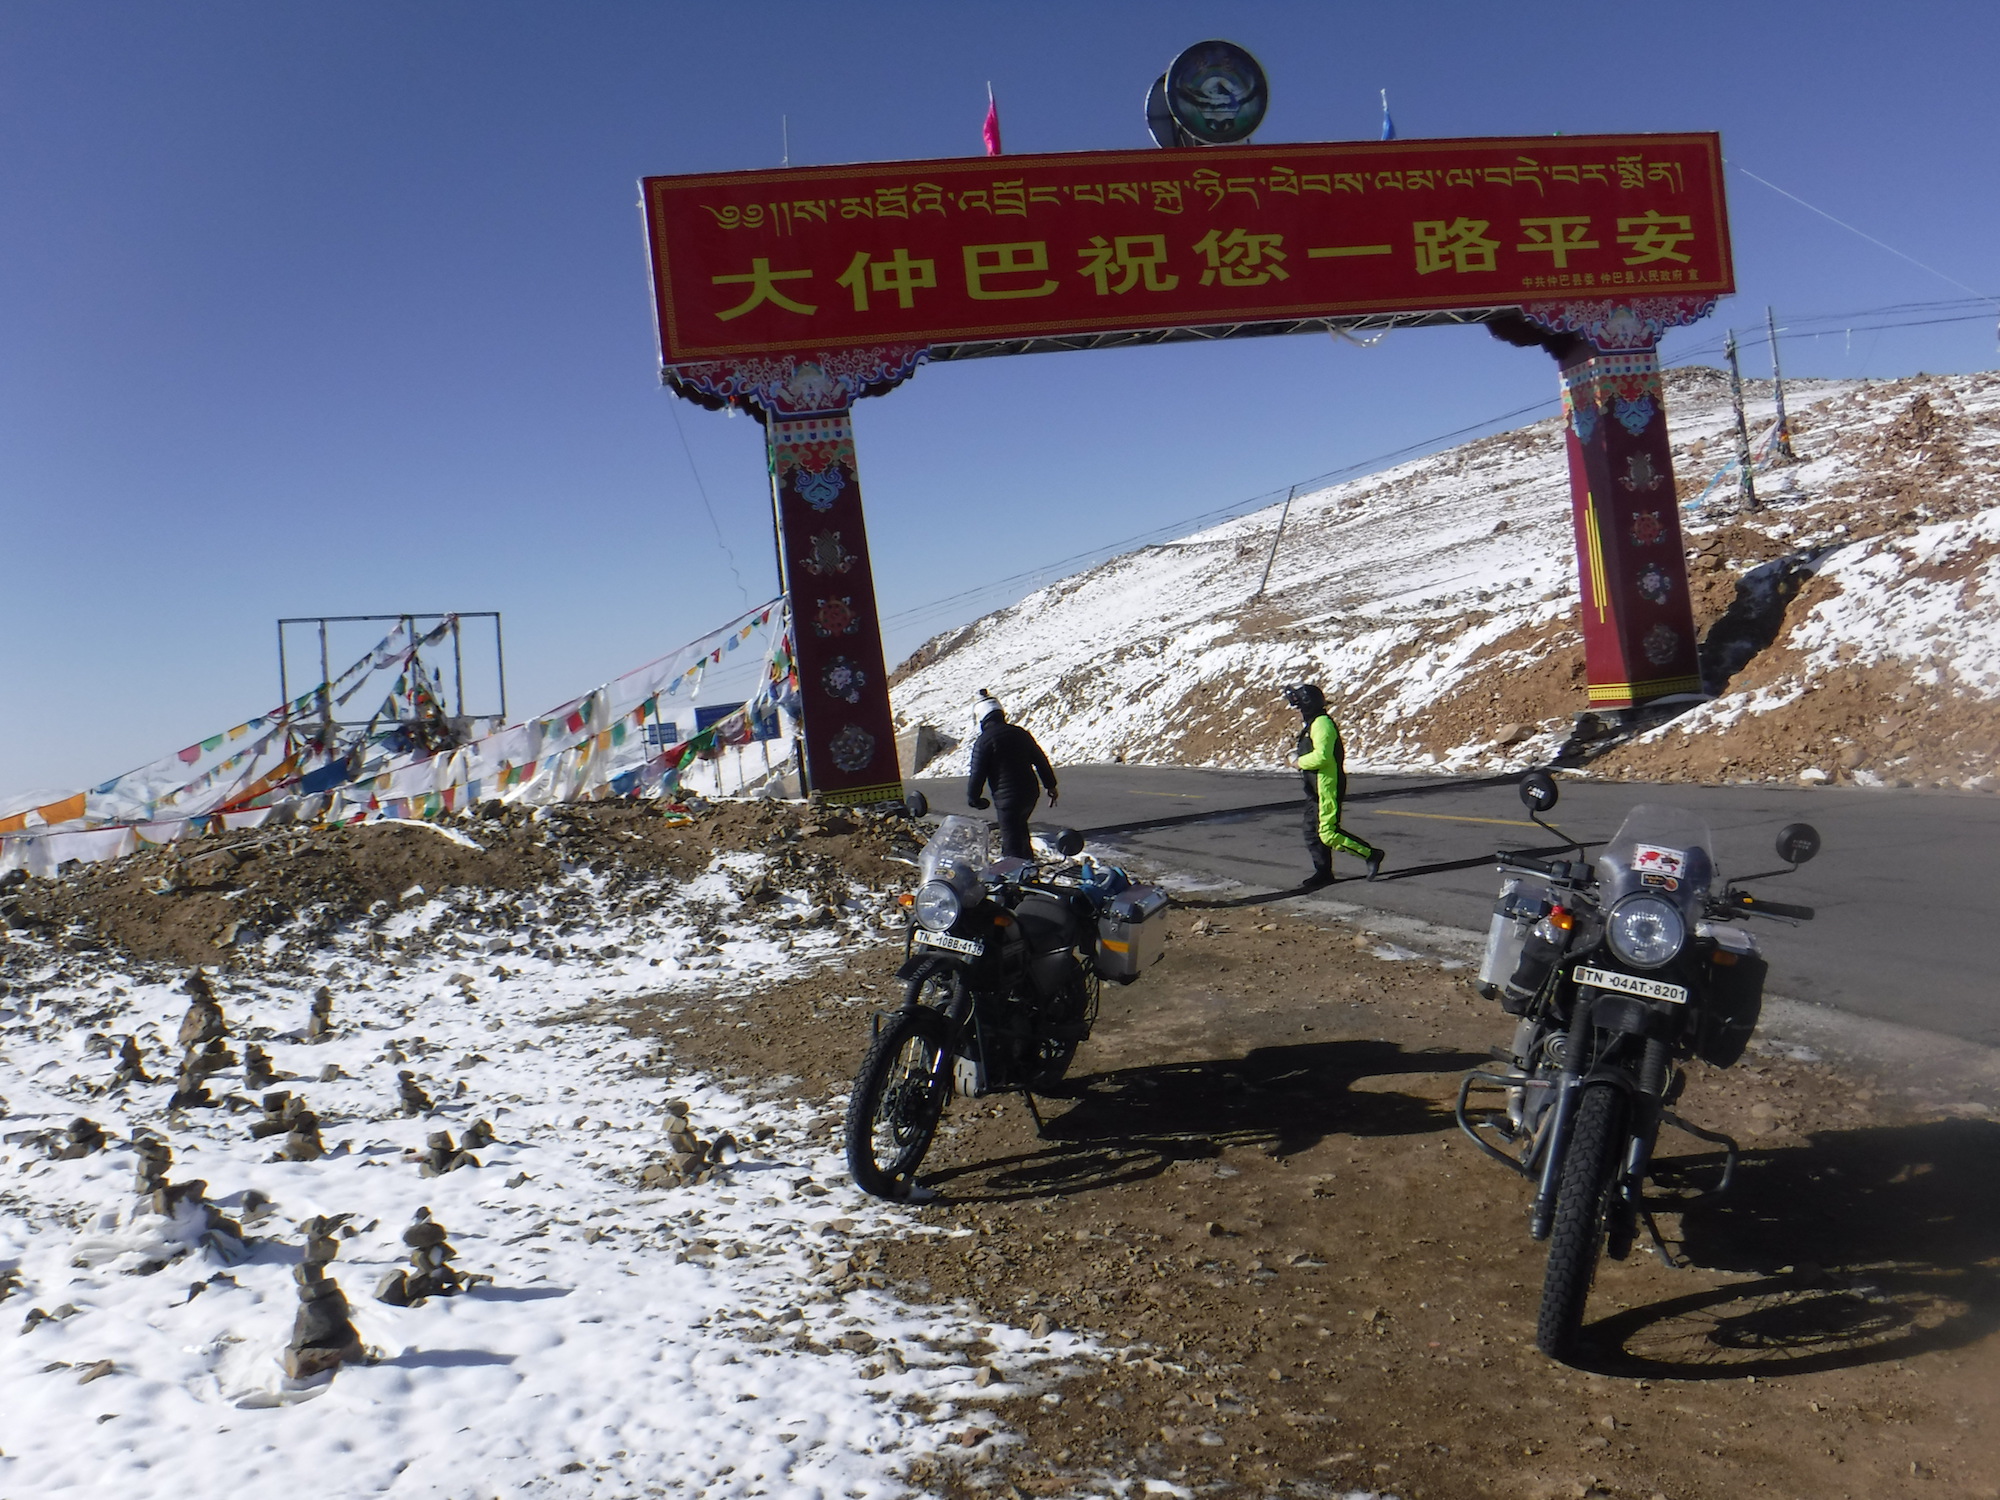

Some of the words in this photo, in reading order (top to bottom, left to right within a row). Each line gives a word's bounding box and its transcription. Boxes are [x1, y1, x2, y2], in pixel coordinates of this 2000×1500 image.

[711, 209, 1696, 322] 大仲巴祝您一路平安
[1586, 970, 1603, 983] TN
